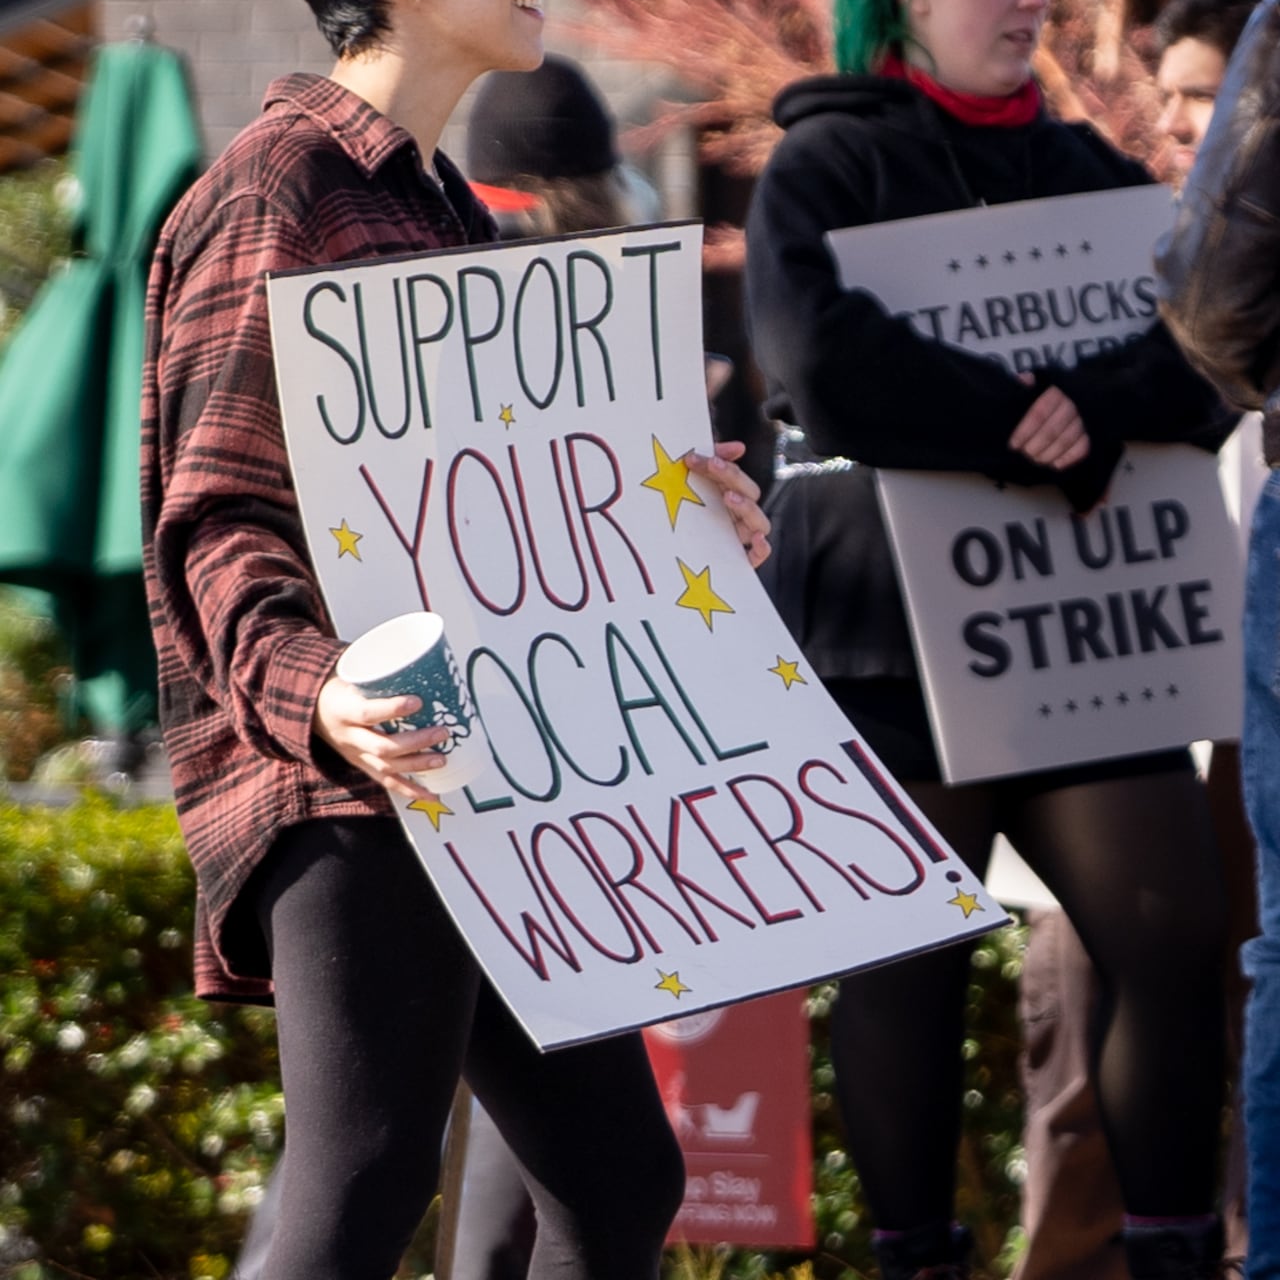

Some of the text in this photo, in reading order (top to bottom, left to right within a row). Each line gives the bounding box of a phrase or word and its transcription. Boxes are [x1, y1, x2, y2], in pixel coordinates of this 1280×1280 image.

[303, 240, 682, 444] SUPPORT
[893, 276, 1157, 344] TARBUCKS
[359, 431, 656, 616] YOUR
[951, 499, 1191, 588] ON ULP
[962, 580, 1223, 678] STRIKE
[442, 739, 962, 982] WORKERS!
